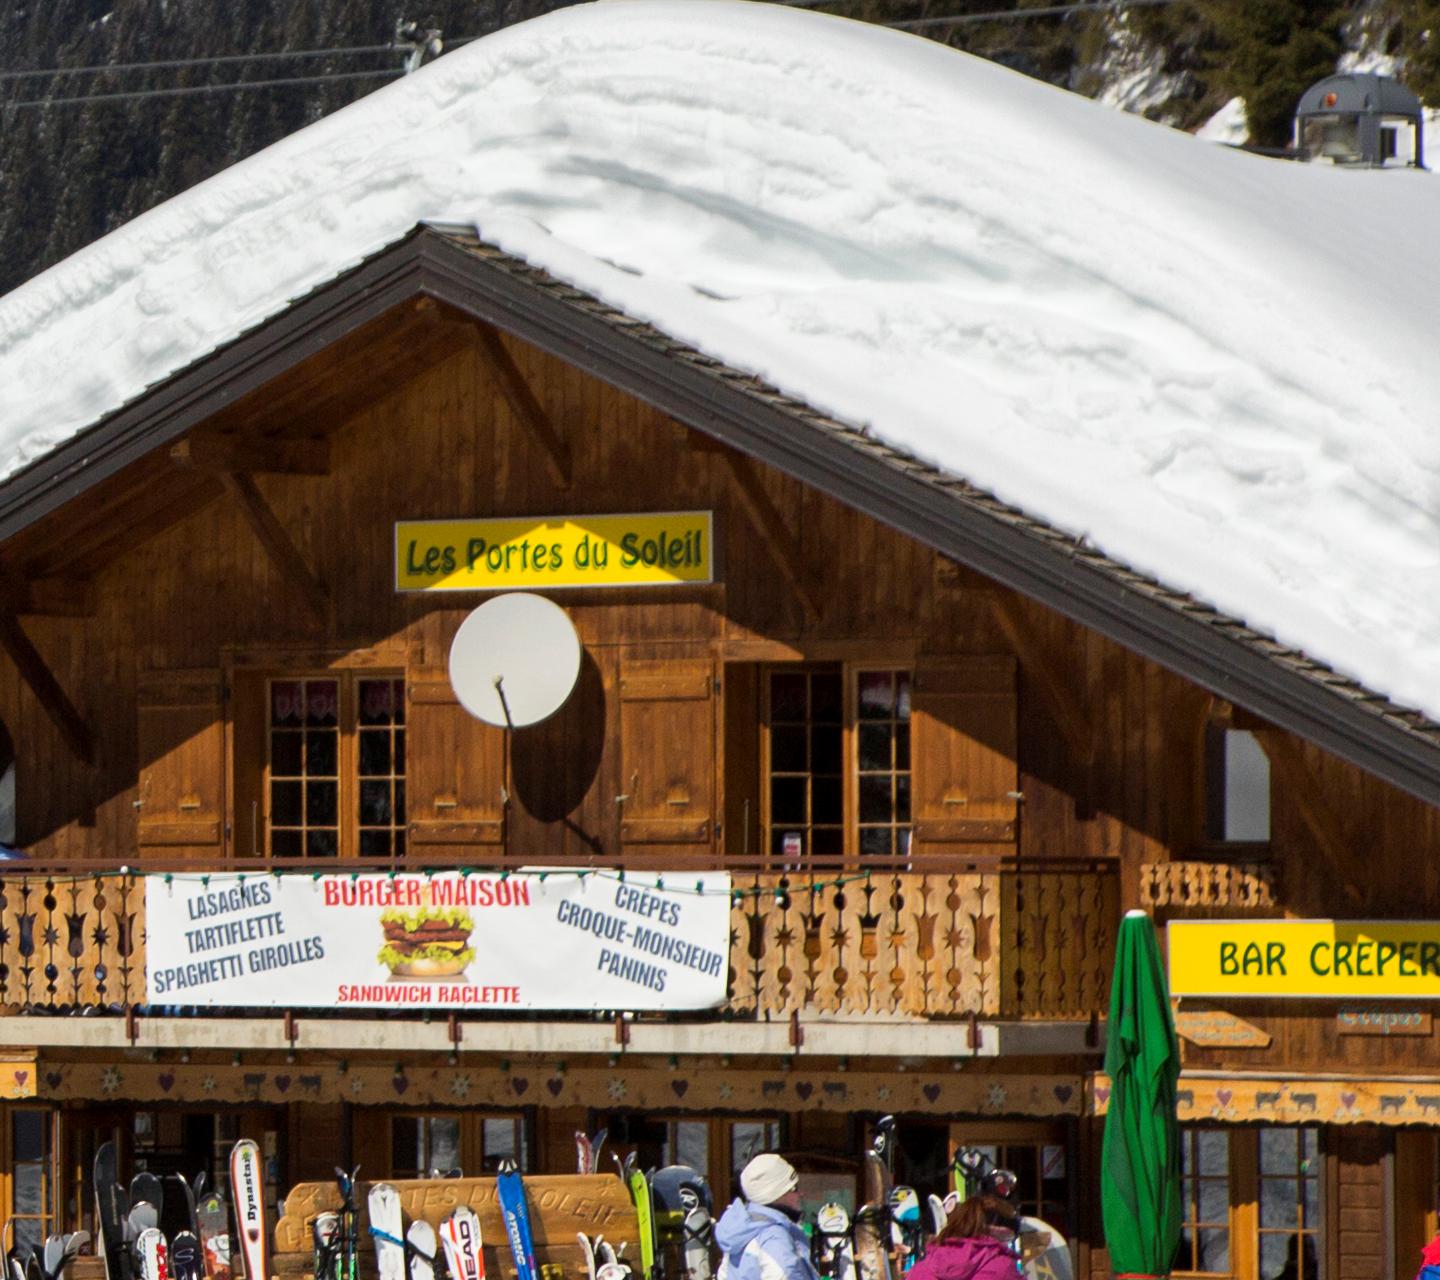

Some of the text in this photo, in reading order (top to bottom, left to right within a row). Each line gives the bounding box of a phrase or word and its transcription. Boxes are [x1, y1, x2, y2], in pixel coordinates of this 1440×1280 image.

[407, 529, 702, 575] Les Portes du Soleil
[187, 881, 272, 921] LASAGNES
[324, 878, 530, 907] BURGER MAISON
[614, 884, 682, 927] CRÊPES
[184, 912, 285, 955] TARTIFLETTE
[556, 898, 724, 979] CROQUE-MONSIEUR
[153, 935, 325, 995] SPAGHETTI GIROLLES
[596, 947, 668, 994] PANINIS
[1220, 941, 1287, 976] BAR
[337, 985, 521, 1004] SANDWICH RACLETTE
[506, 1210, 526, 1266] ATOMIC
